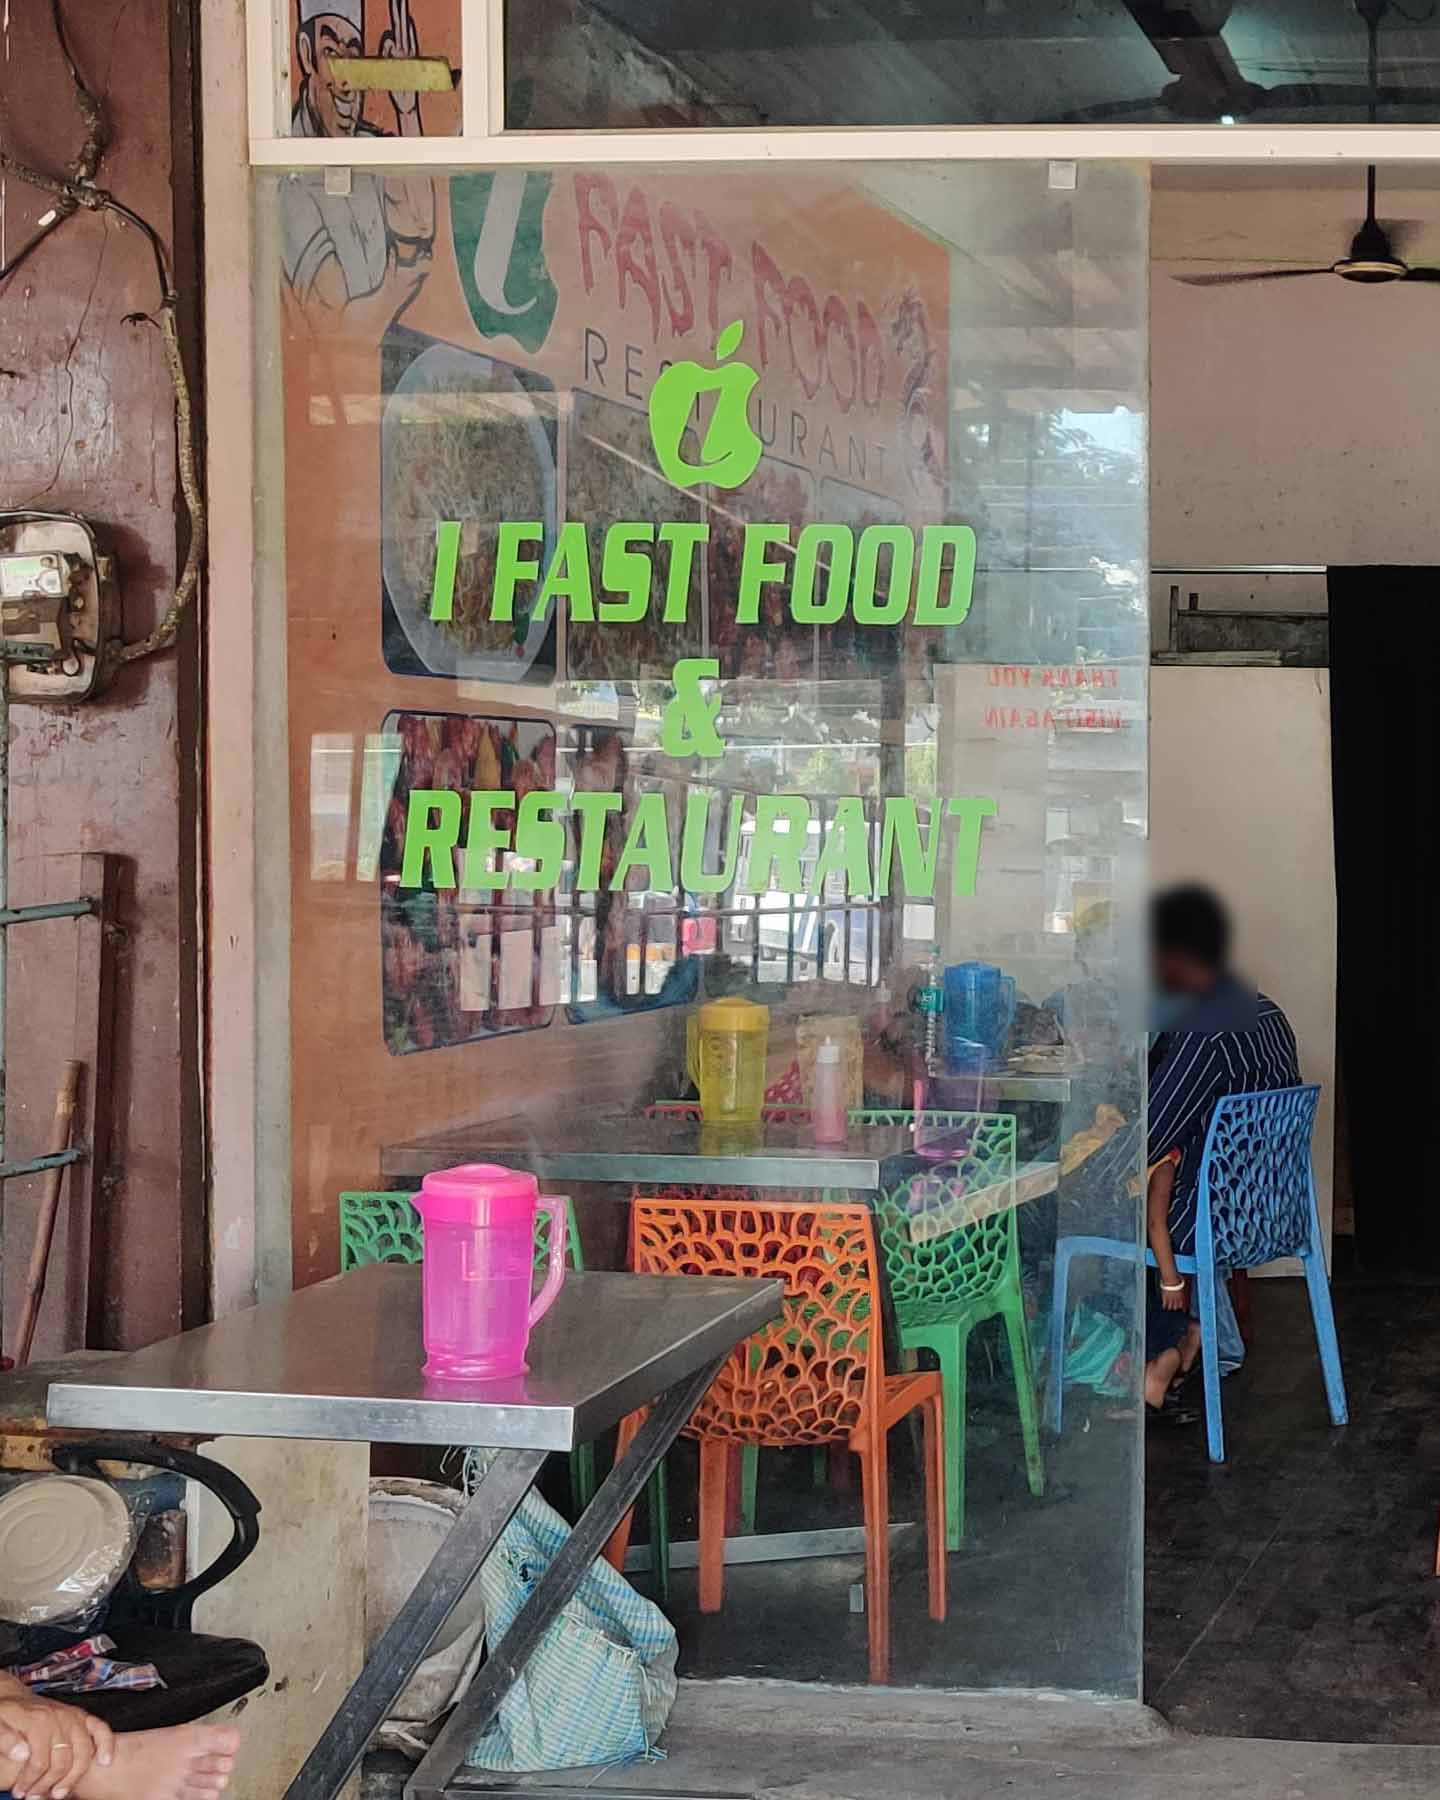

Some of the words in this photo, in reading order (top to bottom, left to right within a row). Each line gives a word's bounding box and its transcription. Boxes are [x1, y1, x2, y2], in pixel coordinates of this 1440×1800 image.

[751, 239, 885, 415] FOOD
[584, 327, 888, 484] REURANT
[430, 521, 462, 622] I
[490, 521, 710, 623] FAST
[735, 523, 978, 626] FOOD
[662, 658, 725, 759] &
[400, 790, 997, 897] RESTAURANT
